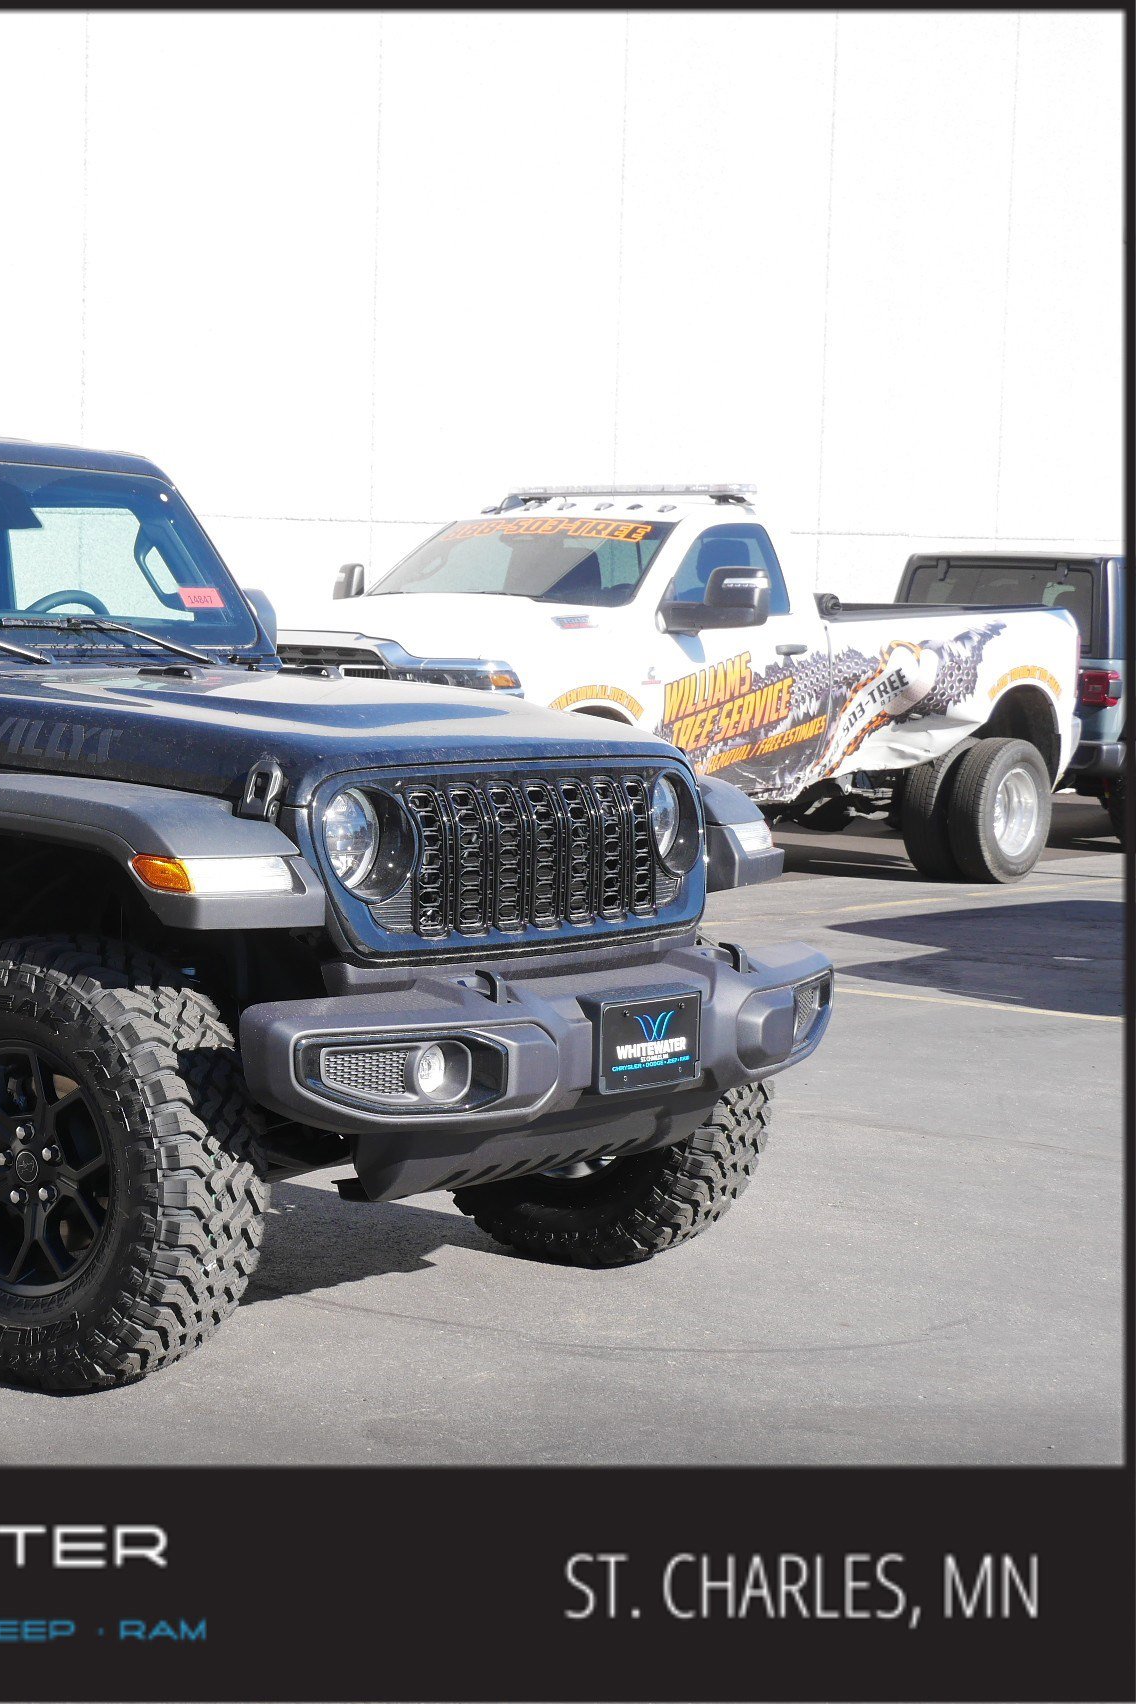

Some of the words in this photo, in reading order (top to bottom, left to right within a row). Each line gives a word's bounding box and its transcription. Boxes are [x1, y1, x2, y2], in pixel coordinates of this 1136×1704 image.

[664, 651, 751, 725] WILLIAMS
[671, 706, 719, 752] TREE
[714, 677, 794, 743] SERVICE
[707, 744, 752, 775] REMOVAL
[756, 733, 785, 756] FREE
[780, 714, 828, 749] ESTIMATES
[611, 1062, 642, 1072] CHRYSLER
[645, 1060, 664, 1068] DODGE
[616, 1036, 687, 1060] WHITEWATER
